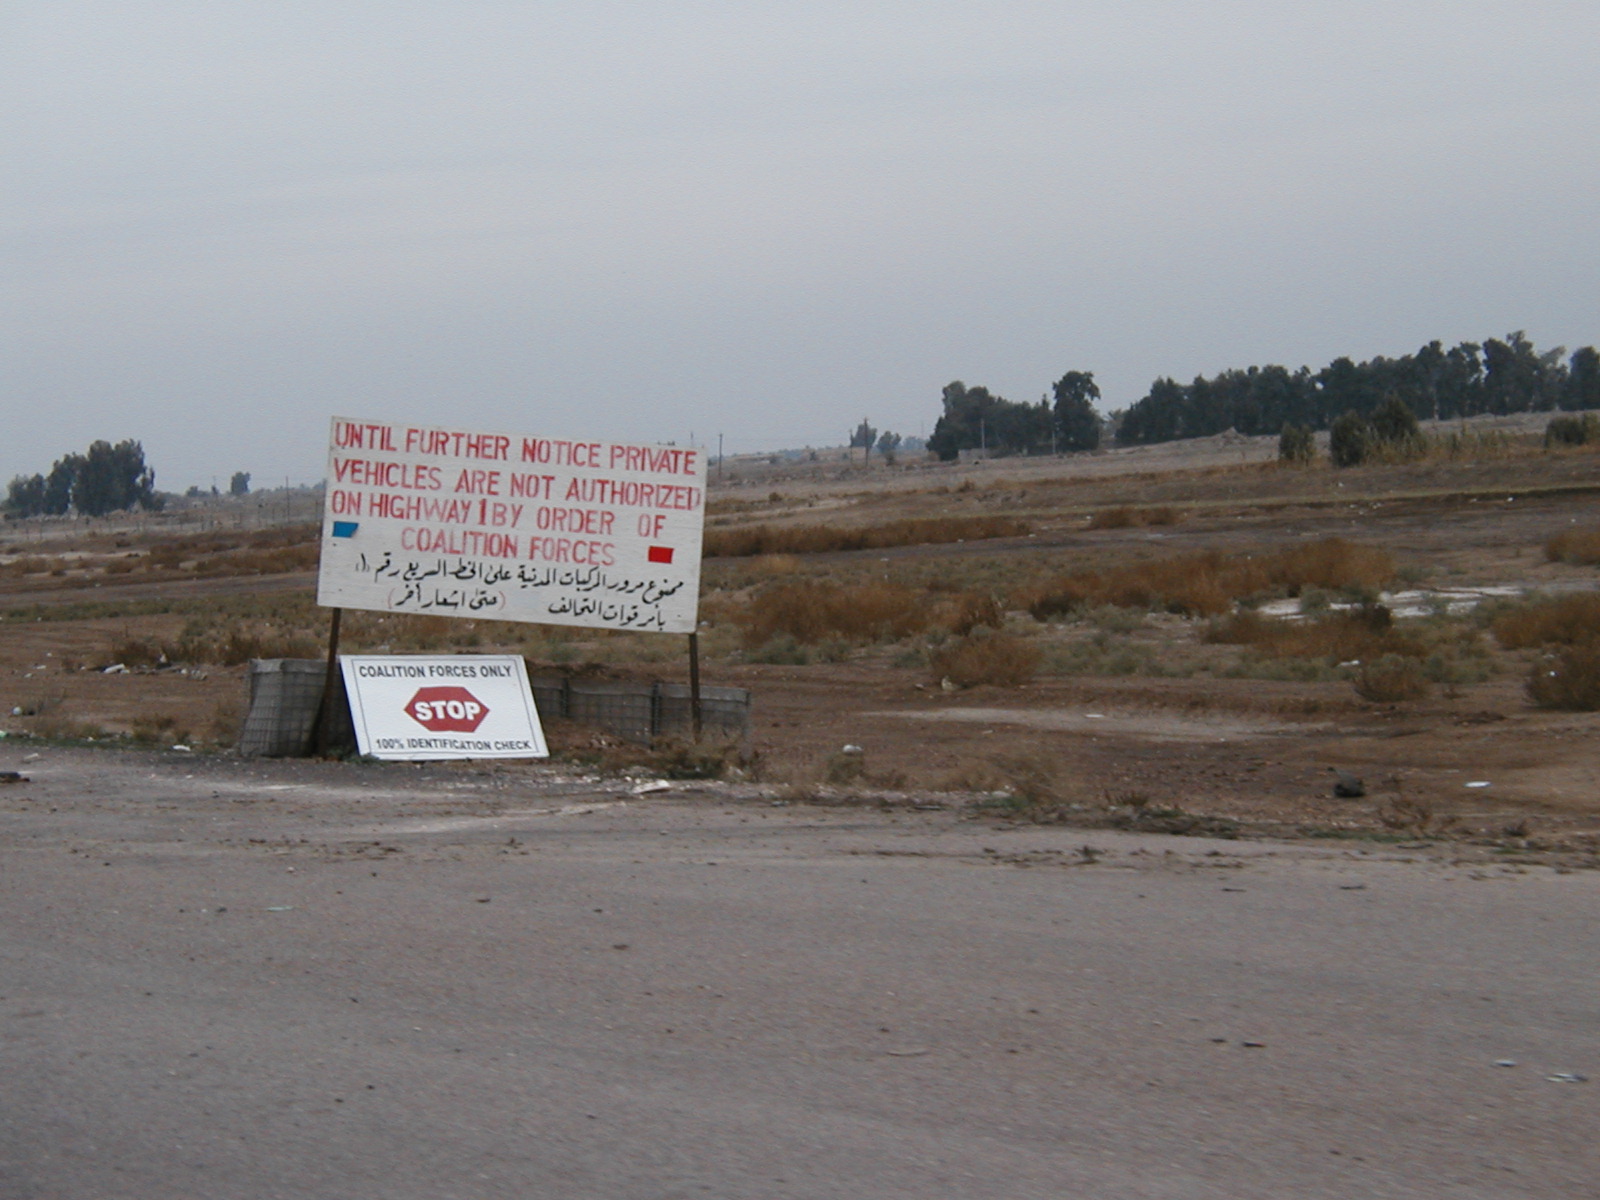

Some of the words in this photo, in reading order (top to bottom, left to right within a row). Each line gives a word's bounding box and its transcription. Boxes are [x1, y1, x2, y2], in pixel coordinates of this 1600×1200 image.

[335, 422, 397, 452] UNTIL
[406, 428, 510, 461] FURTHER
[521, 437, 601, 468] NOTICE
[610, 444, 697, 475] PRIVATE
[334, 457, 442, 491] VEHICLES
[454, 468, 501, 496] ARE
[510, 472, 555, 500] NOT
[565, 477, 701, 511] AUTHORIZED
[332, 490, 362, 516] ON
[369, 492, 471, 525] HIGHWAY
[478, 498, 487, 525] 1
[492, 502, 523, 528] BY
[536, 506, 615, 535] ORDER
[638, 513, 666, 538] OF
[402, 526, 518, 559] COALITION
[529, 536, 615, 566] FORCES
[375, 552, 400, 583] رقم
[403, 559, 447, 581] السريع
[450, 557, 483, 580] الخط
[607, 579, 644, 593] مرور
[642, 578, 684, 604] ممنوع
[548, 597, 602, 616] التحالف
[603, 604, 639, 627] قوات
[359, 665, 425, 678] COALITION
[430, 665, 476, 678] FORCES
[481, 665, 512, 677] ONLY
[414, 700, 481, 721] STOP
[376, 738, 404, 749] 100%
[407, 739, 492, 750] IDENTIFICATION
[494, 740, 531, 750] CHECK
